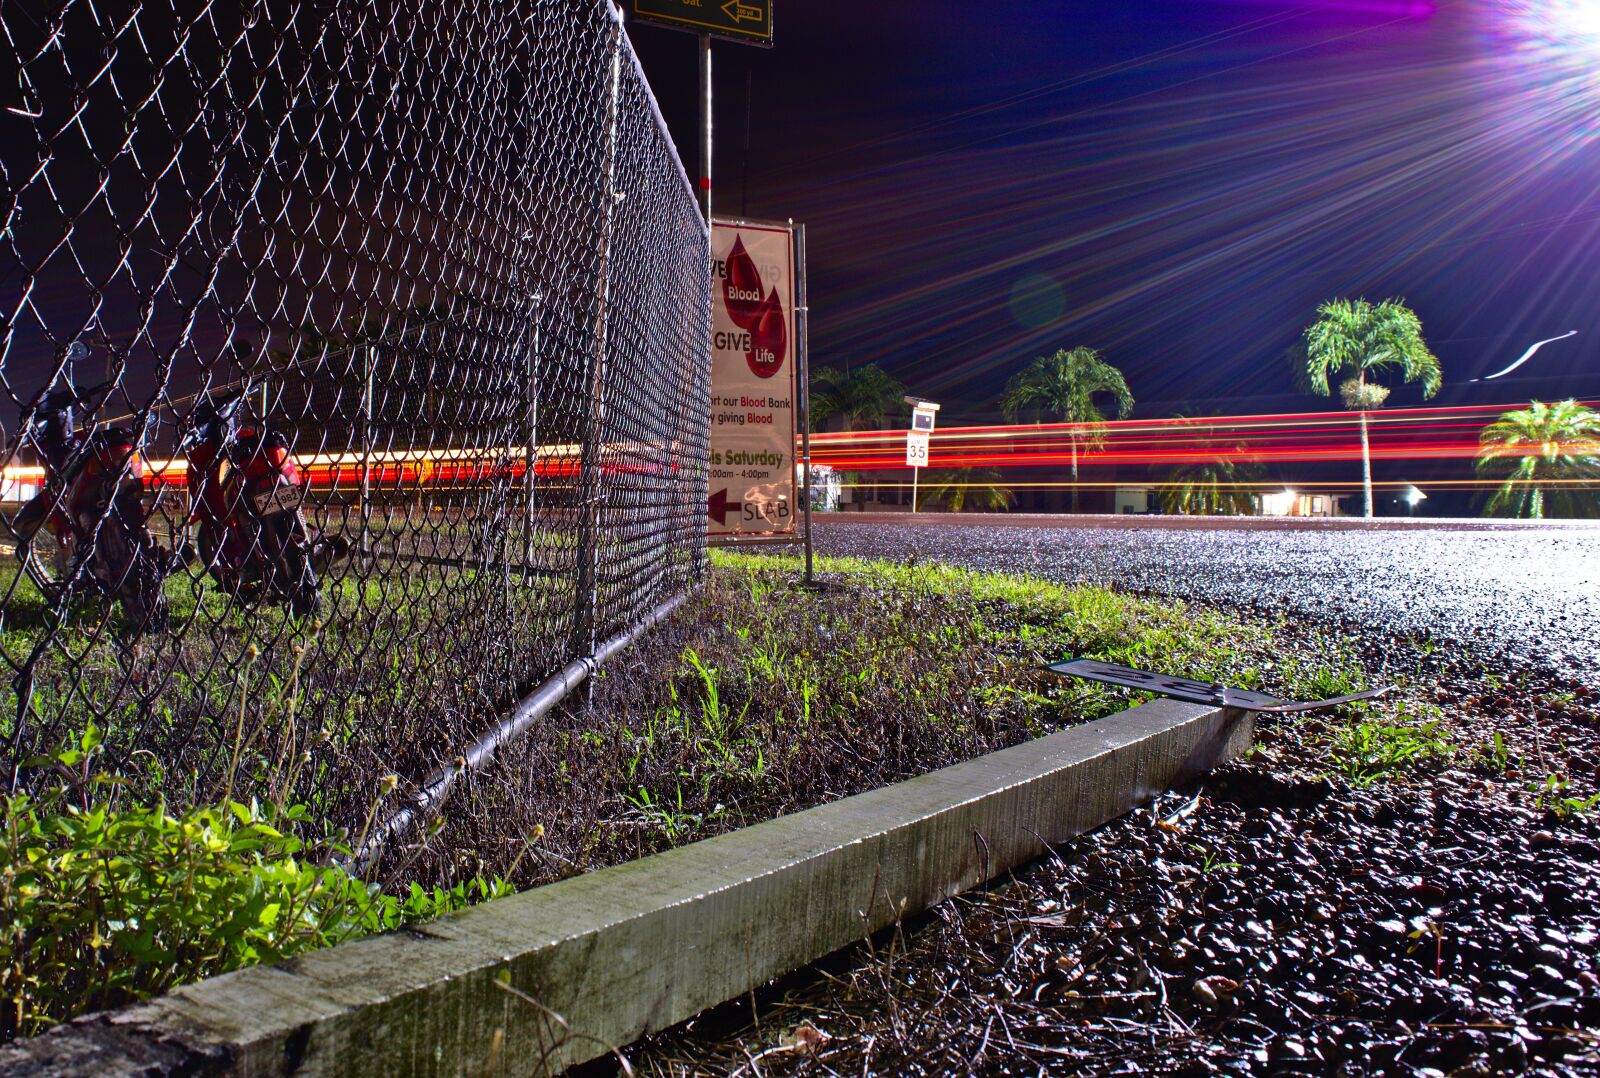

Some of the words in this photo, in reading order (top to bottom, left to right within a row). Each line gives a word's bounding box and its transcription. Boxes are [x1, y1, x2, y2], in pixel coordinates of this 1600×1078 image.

[728, 286, 760, 302] Blood
[714, 332, 751, 352] GIVE
[755, 349, 775, 363] Life
[723, 399, 738, 407] our
[741, 397, 766, 408] Blood
[769, 398, 791, 409] Bank
[718, 411, 745, 425] giving
[748, 413, 773, 424] Blood
[725, 449, 783, 469] Saturday
[910, 445, 926, 459] 35
[741, 470, 769, 480] 4:00pm
[744, 501, 789, 521] SLAB
